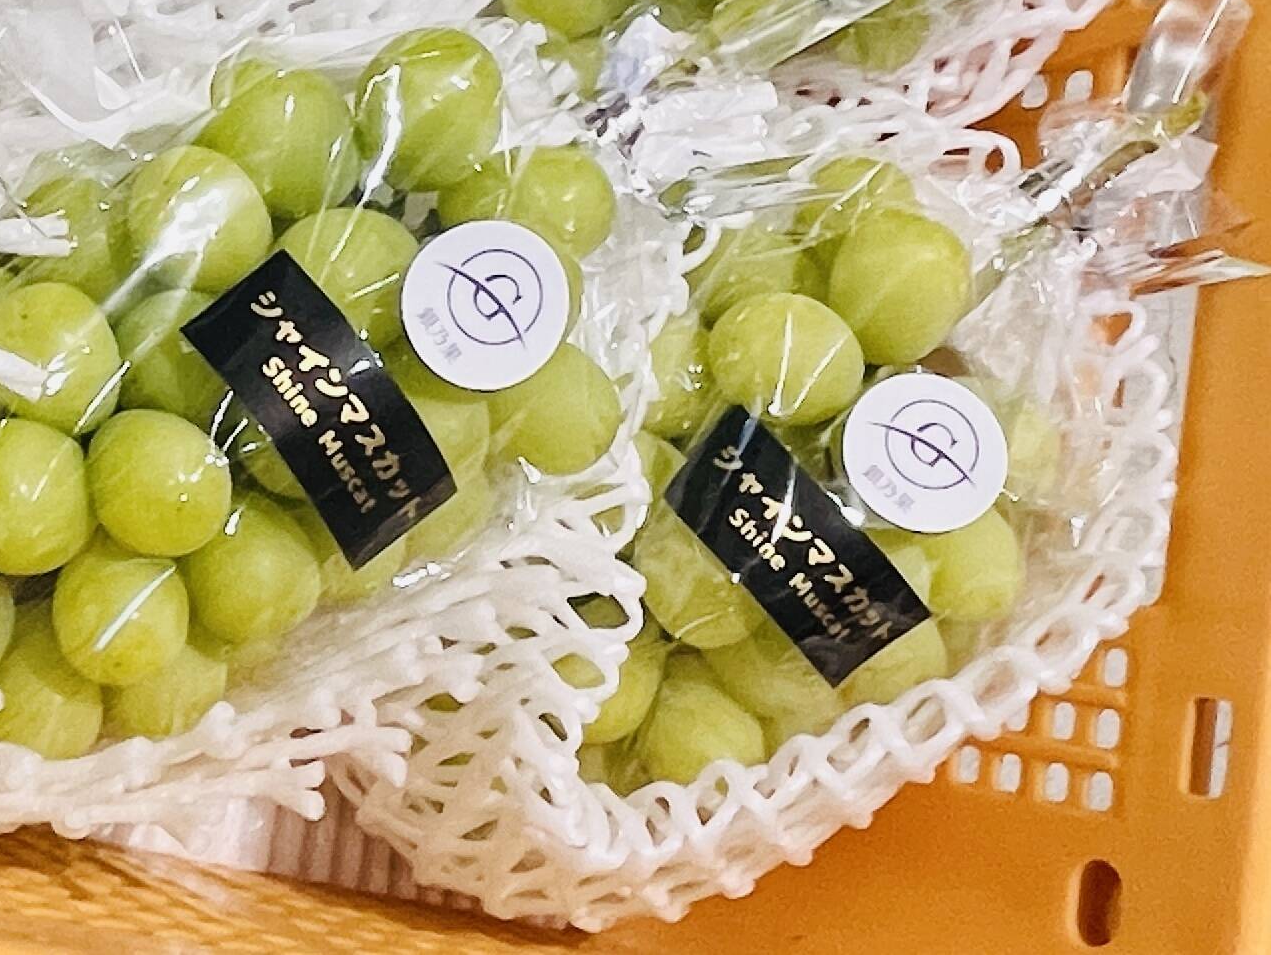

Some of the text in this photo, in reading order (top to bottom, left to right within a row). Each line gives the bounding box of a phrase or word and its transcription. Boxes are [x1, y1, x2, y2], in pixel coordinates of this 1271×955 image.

[250, 291, 423, 518] シャインマスカット
[262, 356, 377, 514] Shine Muscat
[729, 508, 786, 571] Shine
